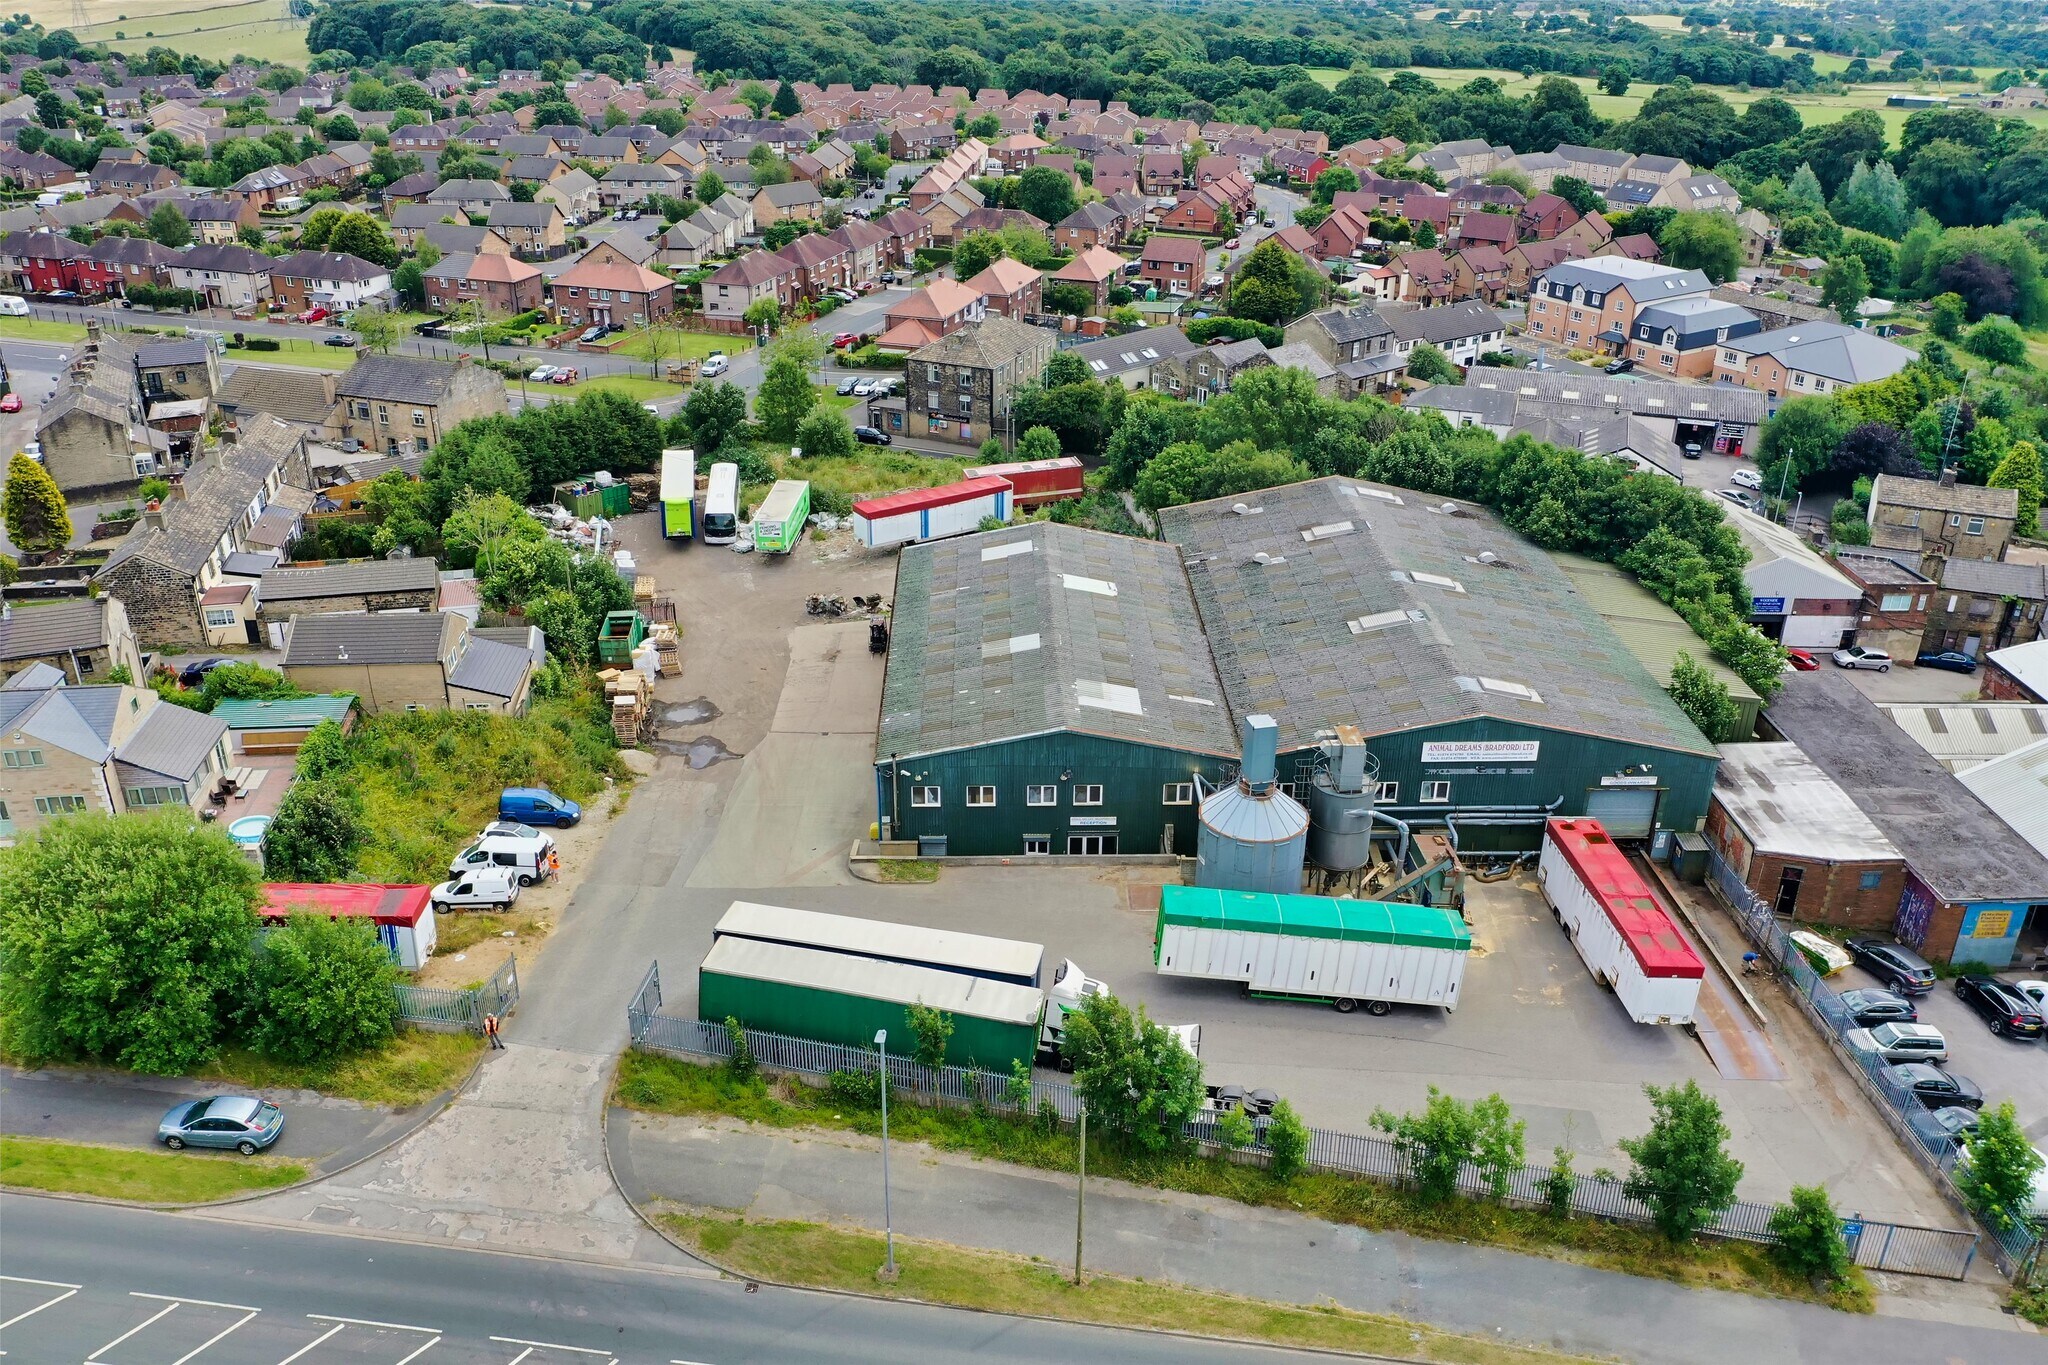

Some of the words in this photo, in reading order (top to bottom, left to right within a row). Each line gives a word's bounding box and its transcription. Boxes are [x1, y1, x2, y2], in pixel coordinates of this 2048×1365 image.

[1428, 744, 1453, 752] ANIMAL
[1455, 744, 1482, 752] DREAMS
[1483, 743, 1522, 751] (BRADFORD)
[1522, 743, 1535, 751] LTD
